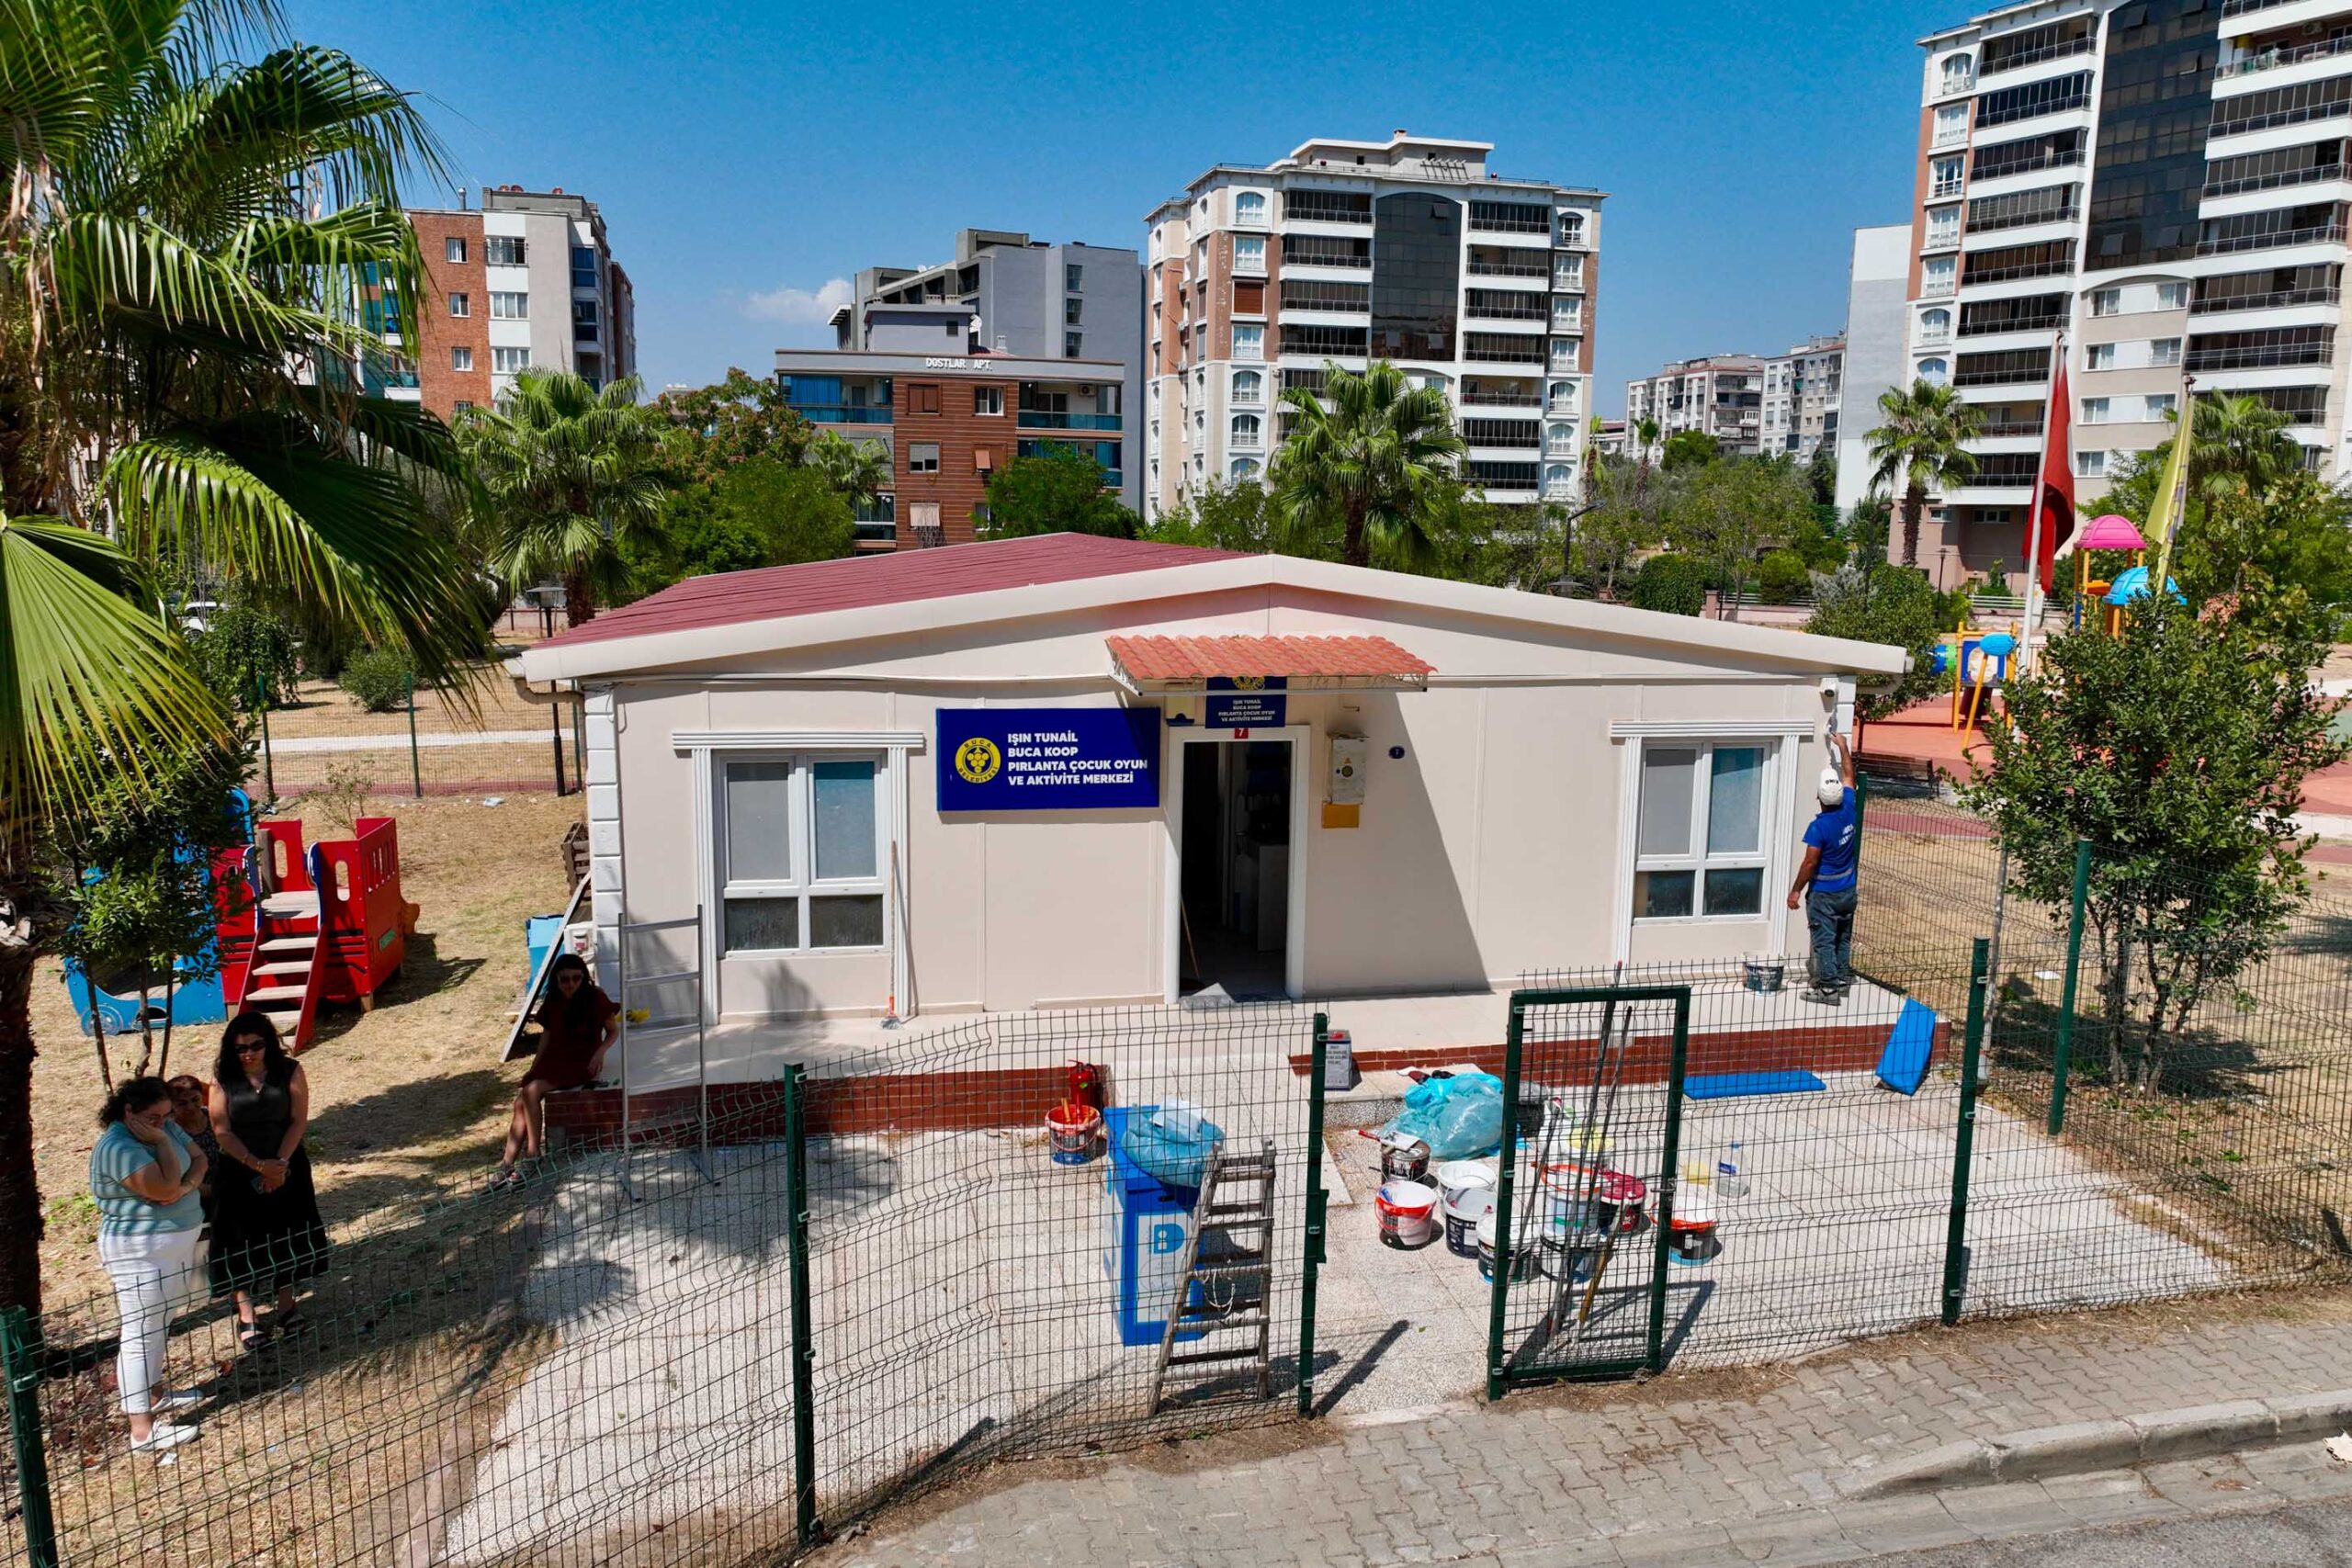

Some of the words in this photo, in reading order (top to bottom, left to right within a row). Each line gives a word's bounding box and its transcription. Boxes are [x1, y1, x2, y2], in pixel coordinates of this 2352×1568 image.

[926, 357, 966, 368] DOSTLAR
[1008, 733, 1032, 746] IŞIN
[1035, 730, 1078, 742] TUNAİL
[1238, 728, 1245, 737] 7
[964, 739, 992, 749] BUCA
[1008, 748, 1041, 757] BUCA
[1045, 747, 1078, 757] KOOP
[1008, 761, 1066, 772] PIRLANTA
[1069, 760, 1111, 773] ÇOCUK
[1114, 760, 1148, 770] OYUN
[1008, 776, 1023, 785] VE
[1026, 773, 1080, 785] AKTİVİTE
[1083, 771, 1133, 784] MERKEZİ
